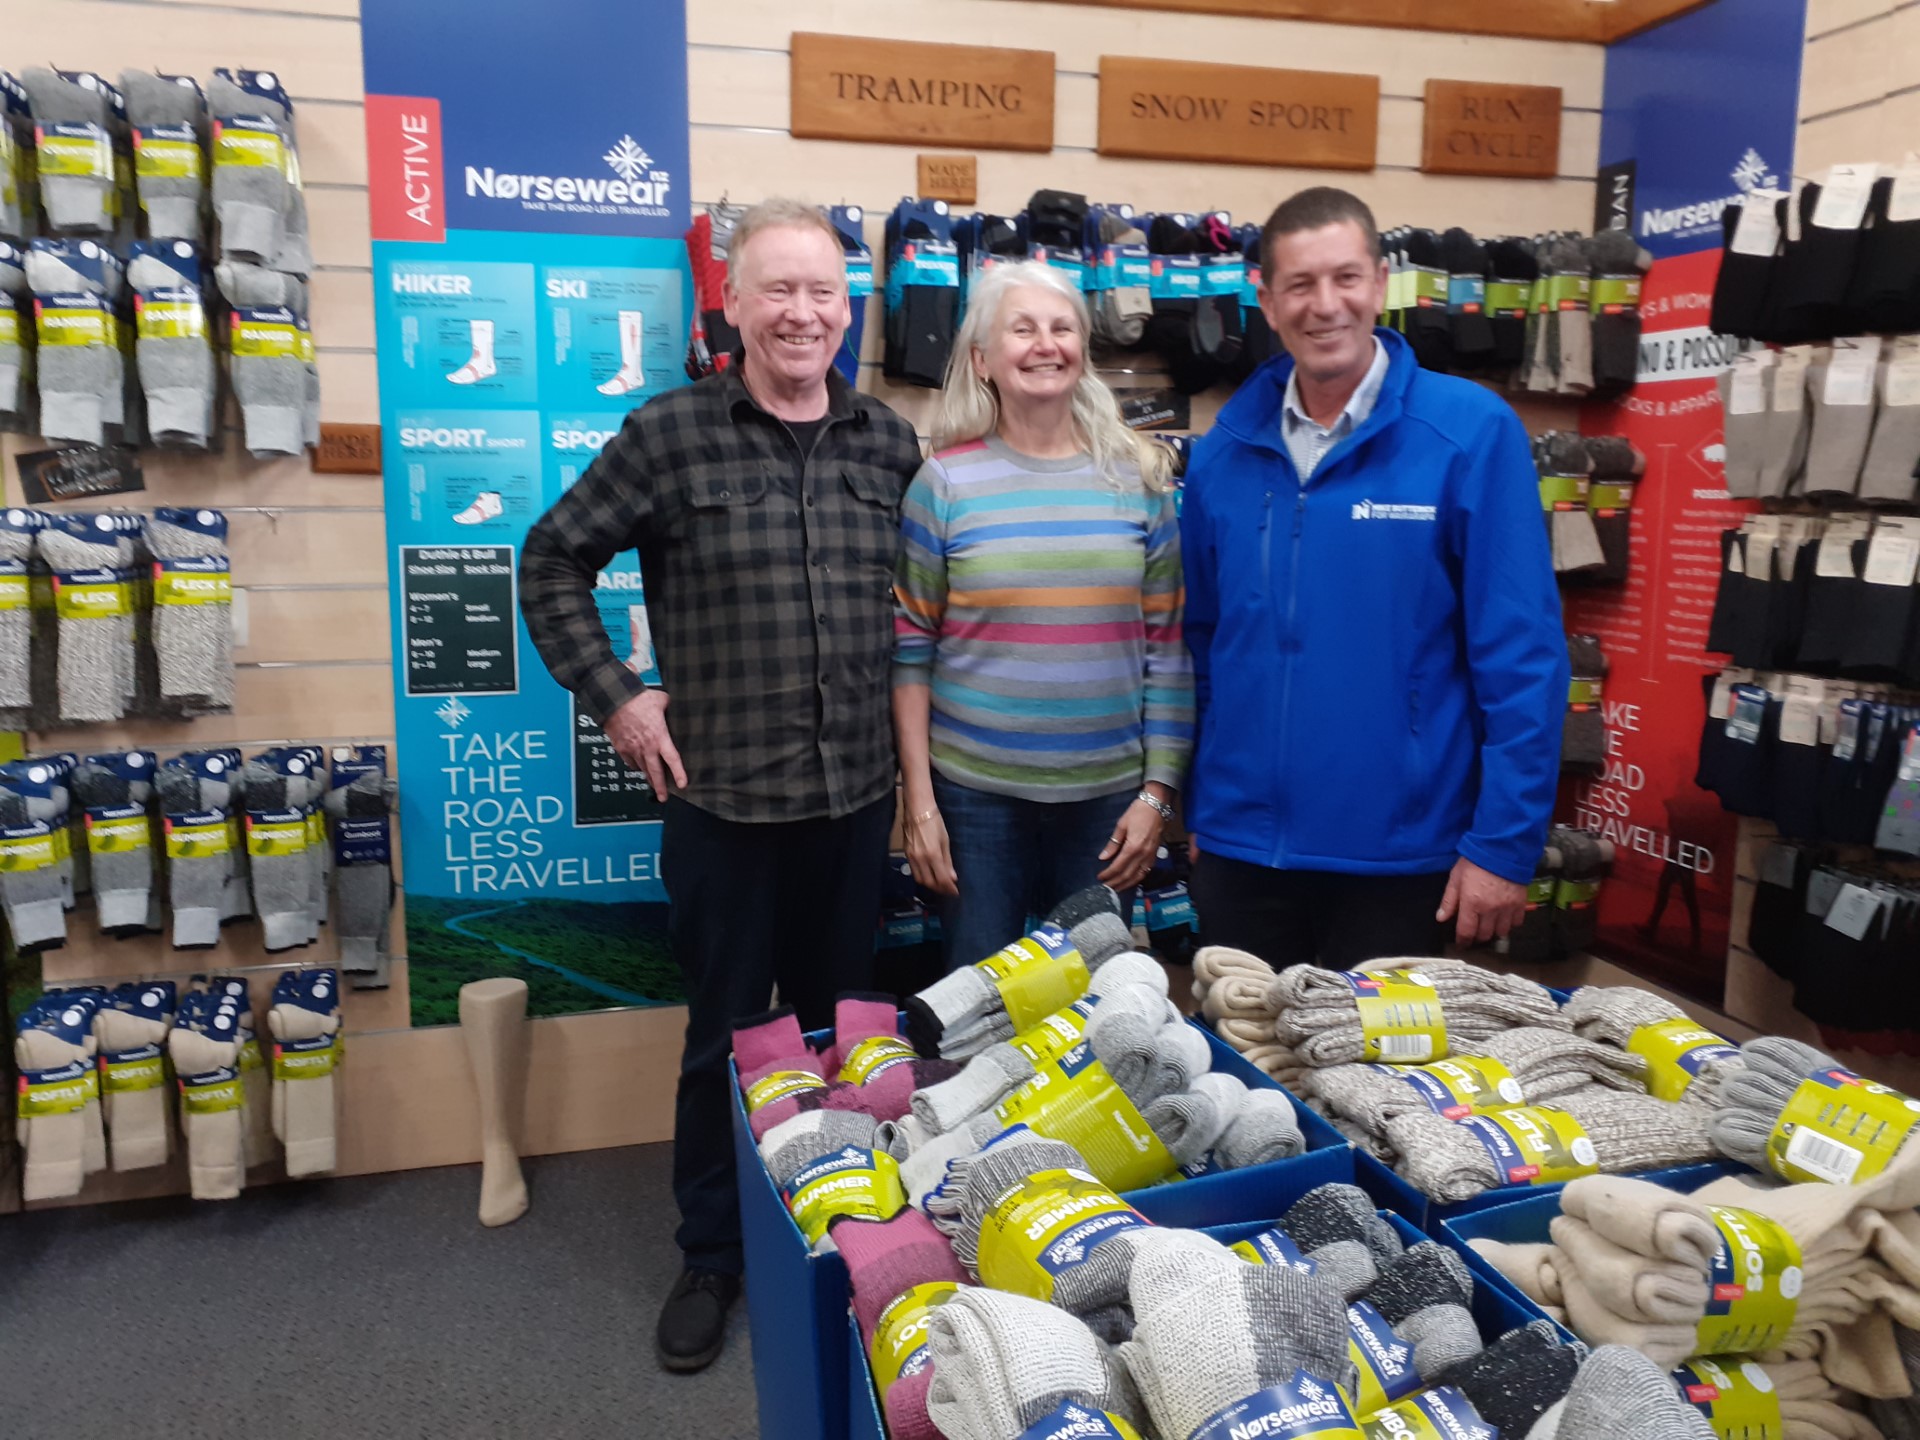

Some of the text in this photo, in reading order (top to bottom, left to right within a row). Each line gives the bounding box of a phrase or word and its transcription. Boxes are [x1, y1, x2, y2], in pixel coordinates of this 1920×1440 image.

[830, 72, 1022, 112] TRAMPING
[1130, 92, 1353, 133] SNOW SPORT
[1462, 96, 1526, 123] RUN
[1447, 129, 1544, 159] CYCLE
[401, 113, 432, 227] ACTIVE
[391, 273, 471, 295] HIKER
[546, 279, 587, 300] SKI
[400, 428, 527, 448] SPORT SHORT
[439, 730, 548, 762] TAKE
[440, 764, 523, 796] THE
[443, 795, 564, 830] ROAD
[445, 828, 544, 862] LESS
[1574, 806, 1715, 874] TRAVELLED
[793, 1176, 872, 1217] SUMMER
[1025, 1195, 1119, 1241] SUMMER
